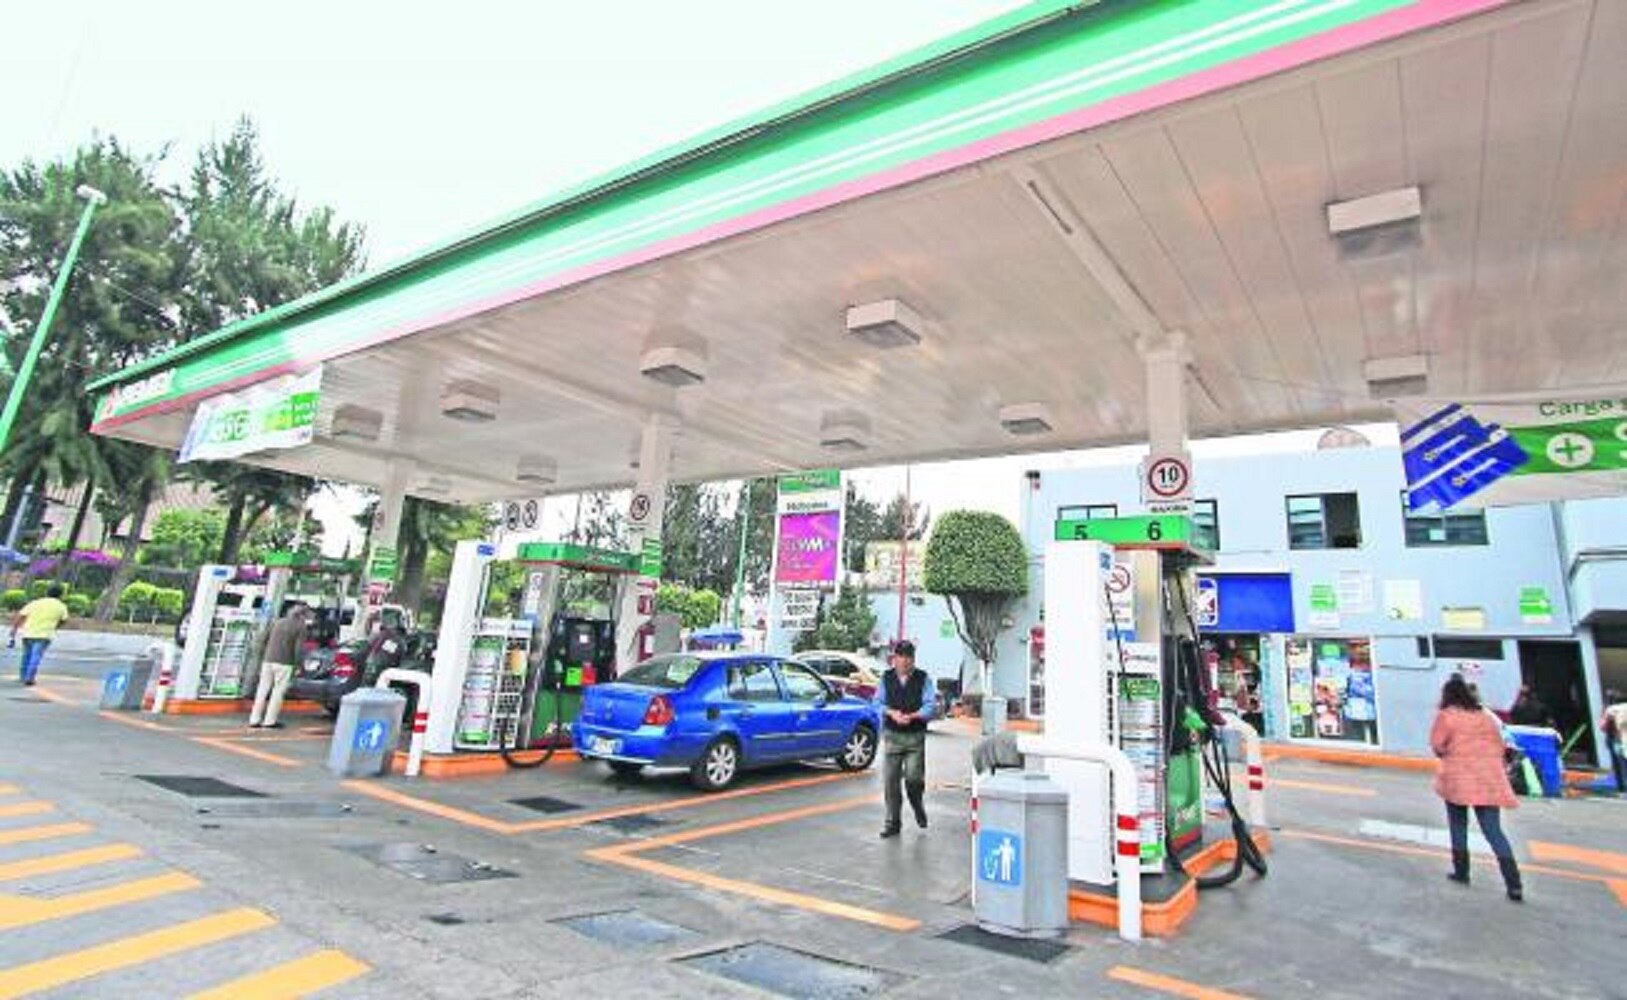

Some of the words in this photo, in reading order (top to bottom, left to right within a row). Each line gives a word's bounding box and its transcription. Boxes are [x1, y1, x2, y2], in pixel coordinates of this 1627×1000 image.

[1539, 399, 1614, 416] Carga
[1157, 466, 1179, 483] 10
[1147, 521, 1161, 541] 6
